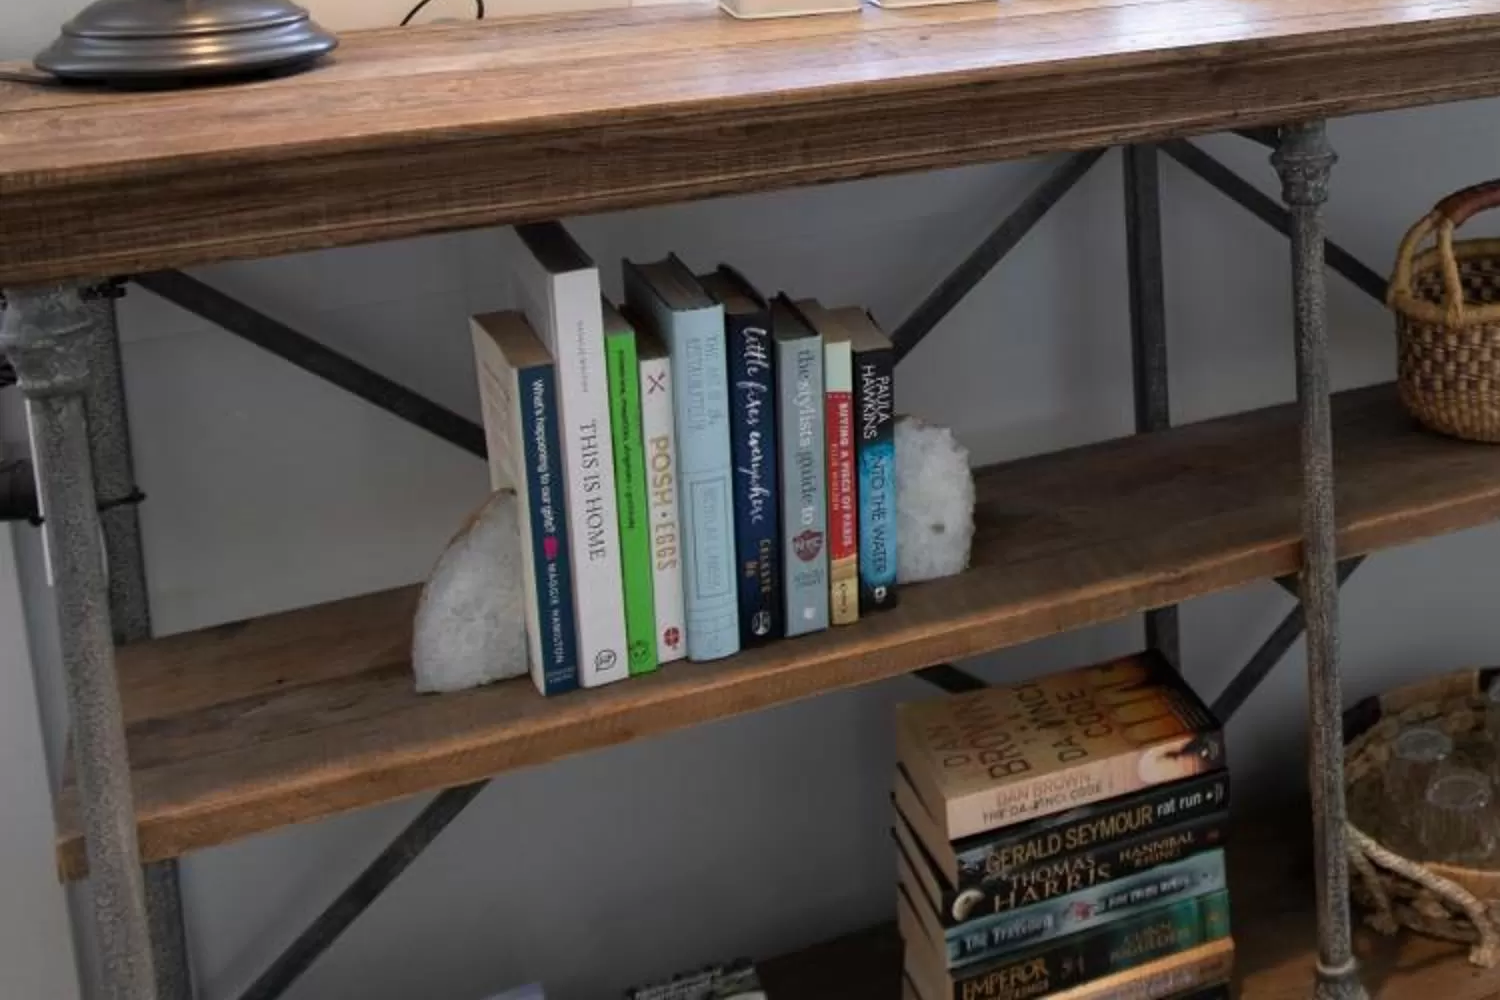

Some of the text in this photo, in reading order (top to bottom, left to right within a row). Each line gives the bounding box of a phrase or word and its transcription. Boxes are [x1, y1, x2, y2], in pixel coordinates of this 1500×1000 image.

[798, 349, 816, 375] the
[532, 377, 546, 417] What's
[736, 380, 769, 426] fires
[861, 364, 878, 440] HAWKINS
[877, 375, 892, 424] PAULA
[535, 417, 548, 473] happening
[540, 473, 550, 485] to
[541, 486, 551, 504] our
[579, 419, 607, 562] THIS IS HOME
[738, 431, 771, 525] everywhere
[796, 450, 817, 500] guide
[649, 436, 678, 572] POSH EGGS
[801, 505, 814, 525] to
[871, 492, 888, 521] THE
[872, 524, 888, 574] WATER
[1056, 688, 1114, 738] CODE
[1052, 735, 1088, 763] DA
[1031, 772, 1092, 800] BROWN
[984, 792, 1202, 874] GERALD SEYMOUR rat run
[1119, 830, 1196, 863] HANNIBAL
[994, 861, 1112, 914] HARRIS
[1011, 854, 1096, 887] THOMAS
[961, 957, 1050, 1000] EMPEROR
